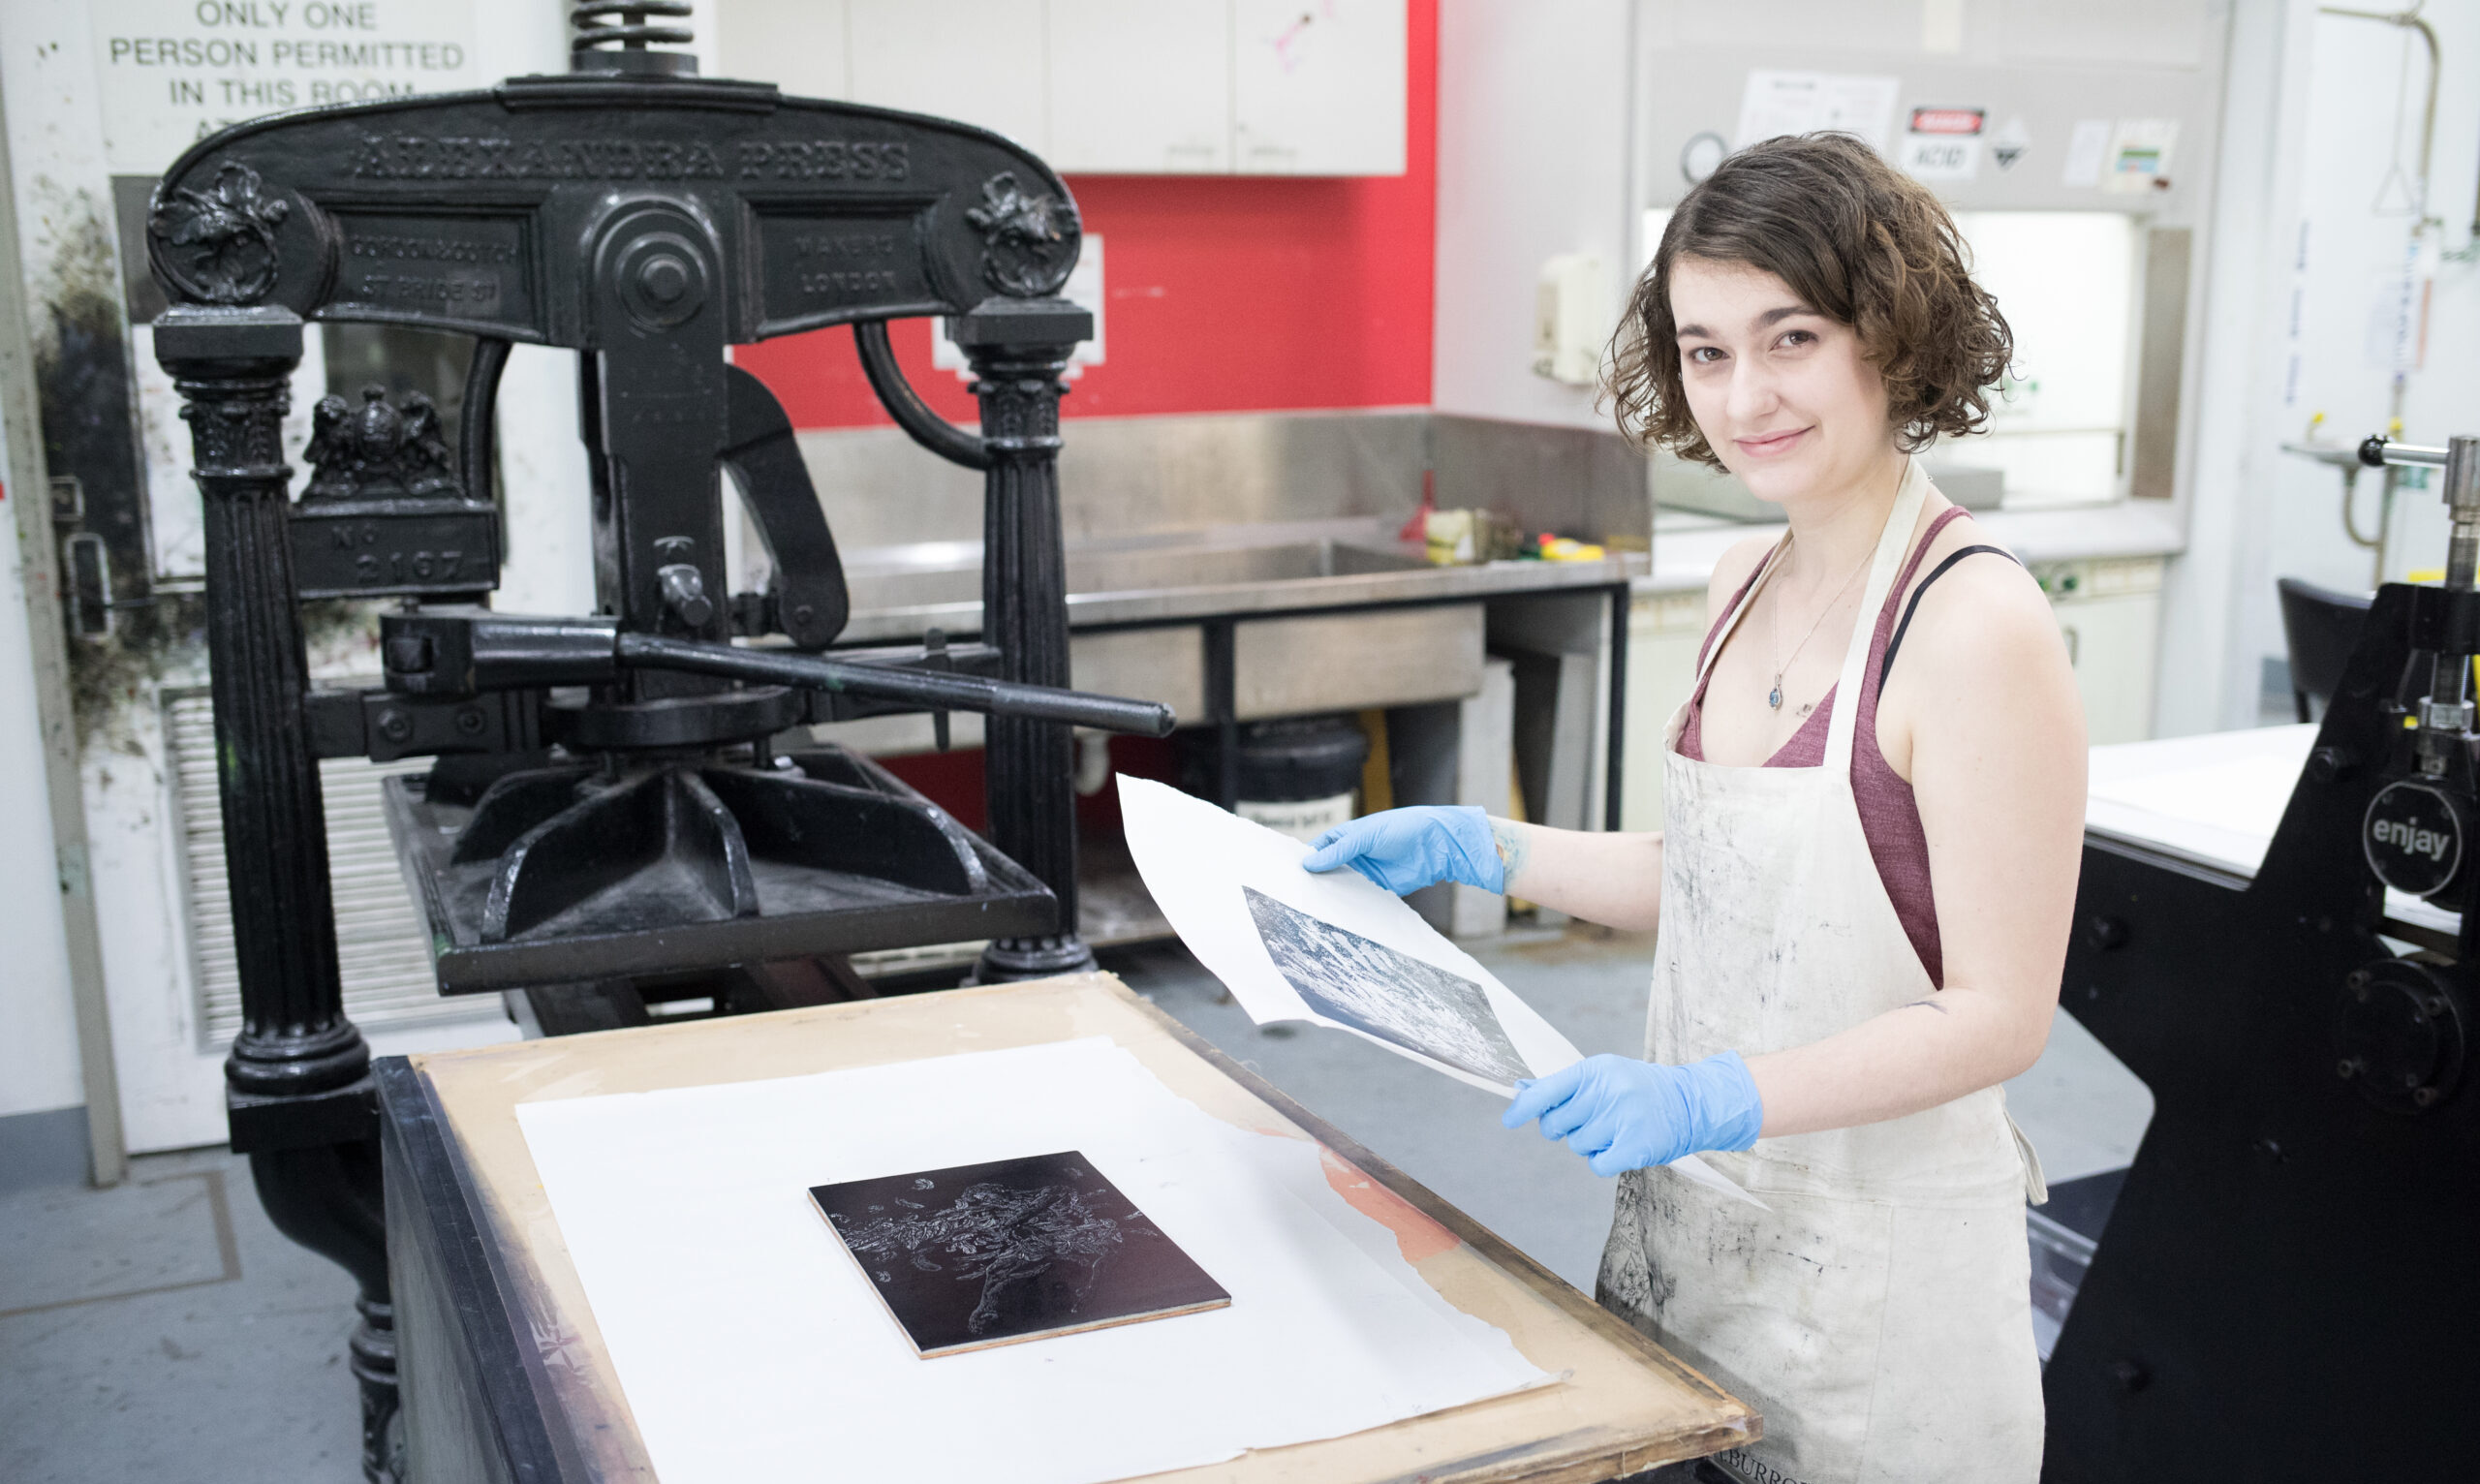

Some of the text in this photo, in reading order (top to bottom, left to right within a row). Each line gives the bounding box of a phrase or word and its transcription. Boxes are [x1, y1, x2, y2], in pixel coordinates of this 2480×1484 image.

[196, 0, 377, 30] ONLY ONE
[109, 39, 465, 70] PERSON PERMITTED
[170, 79, 204, 105] IN
[217, 79, 297, 107] THIS
[355, 136, 910, 181] ALEXANDRA PRESS
[800, 270, 896, 294] LONDON
[355, 549, 463, 584] 2167
[2373, 817, 2449, 862] enjay
